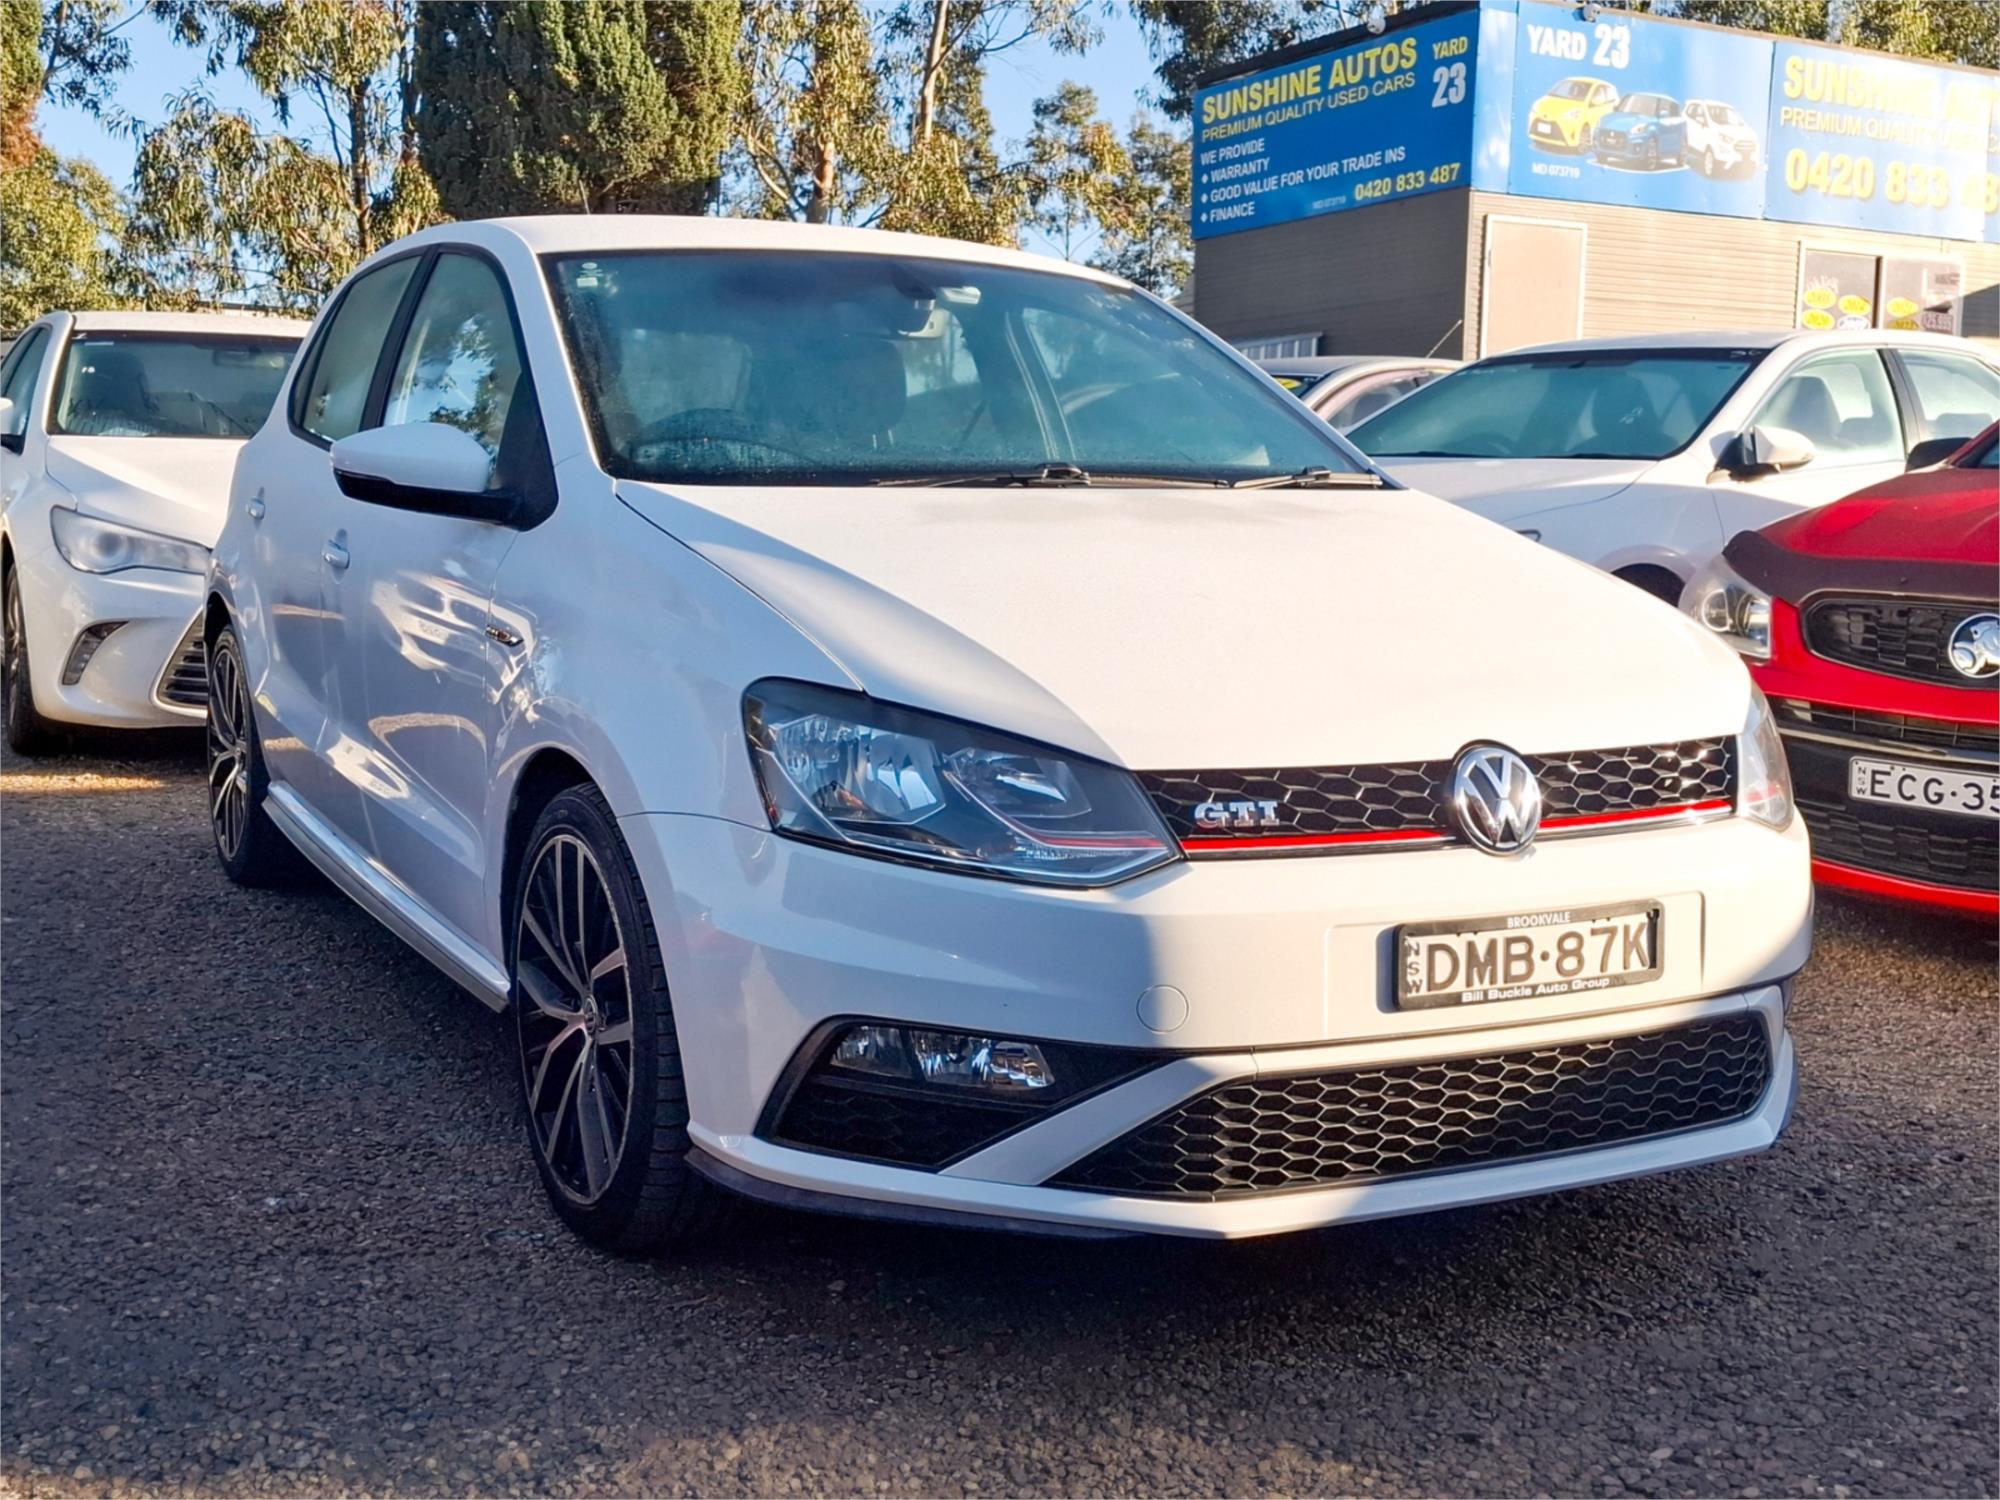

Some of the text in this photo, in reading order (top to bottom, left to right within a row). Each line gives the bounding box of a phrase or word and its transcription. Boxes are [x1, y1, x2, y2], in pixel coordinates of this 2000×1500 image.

[1432, 36, 1468, 60] YARD
[1527, 23, 1630, 69] YARD 23
[1202, 37, 1417, 124] SUNSHINE AUTOS
[1431, 62, 1466, 108] 23
[1201, 72, 1415, 143] PREMIUM QUALITY USED CARS
[1781, 106, 1861, 136] PREMIUM
[1201, 138, 1265, 166] WE PROVIDE
[1210, 146, 1405, 203] GOOD VALUE FOR YOUR TRADE INS
[1211, 157, 1270, 183] WARRANTY
[1355, 162, 1460, 201] 0420 833 487
[1785, 148, 1875, 200] 0420
[1885, 160, 1951, 209] 833
[1210, 201, 1255, 223] FINANCE
[1194, 800, 1280, 829] GTI
[1507, 911, 1570, 928] BROOKVALE
[1462, 977, 1610, 1003] Bill Buckle Auto Group
